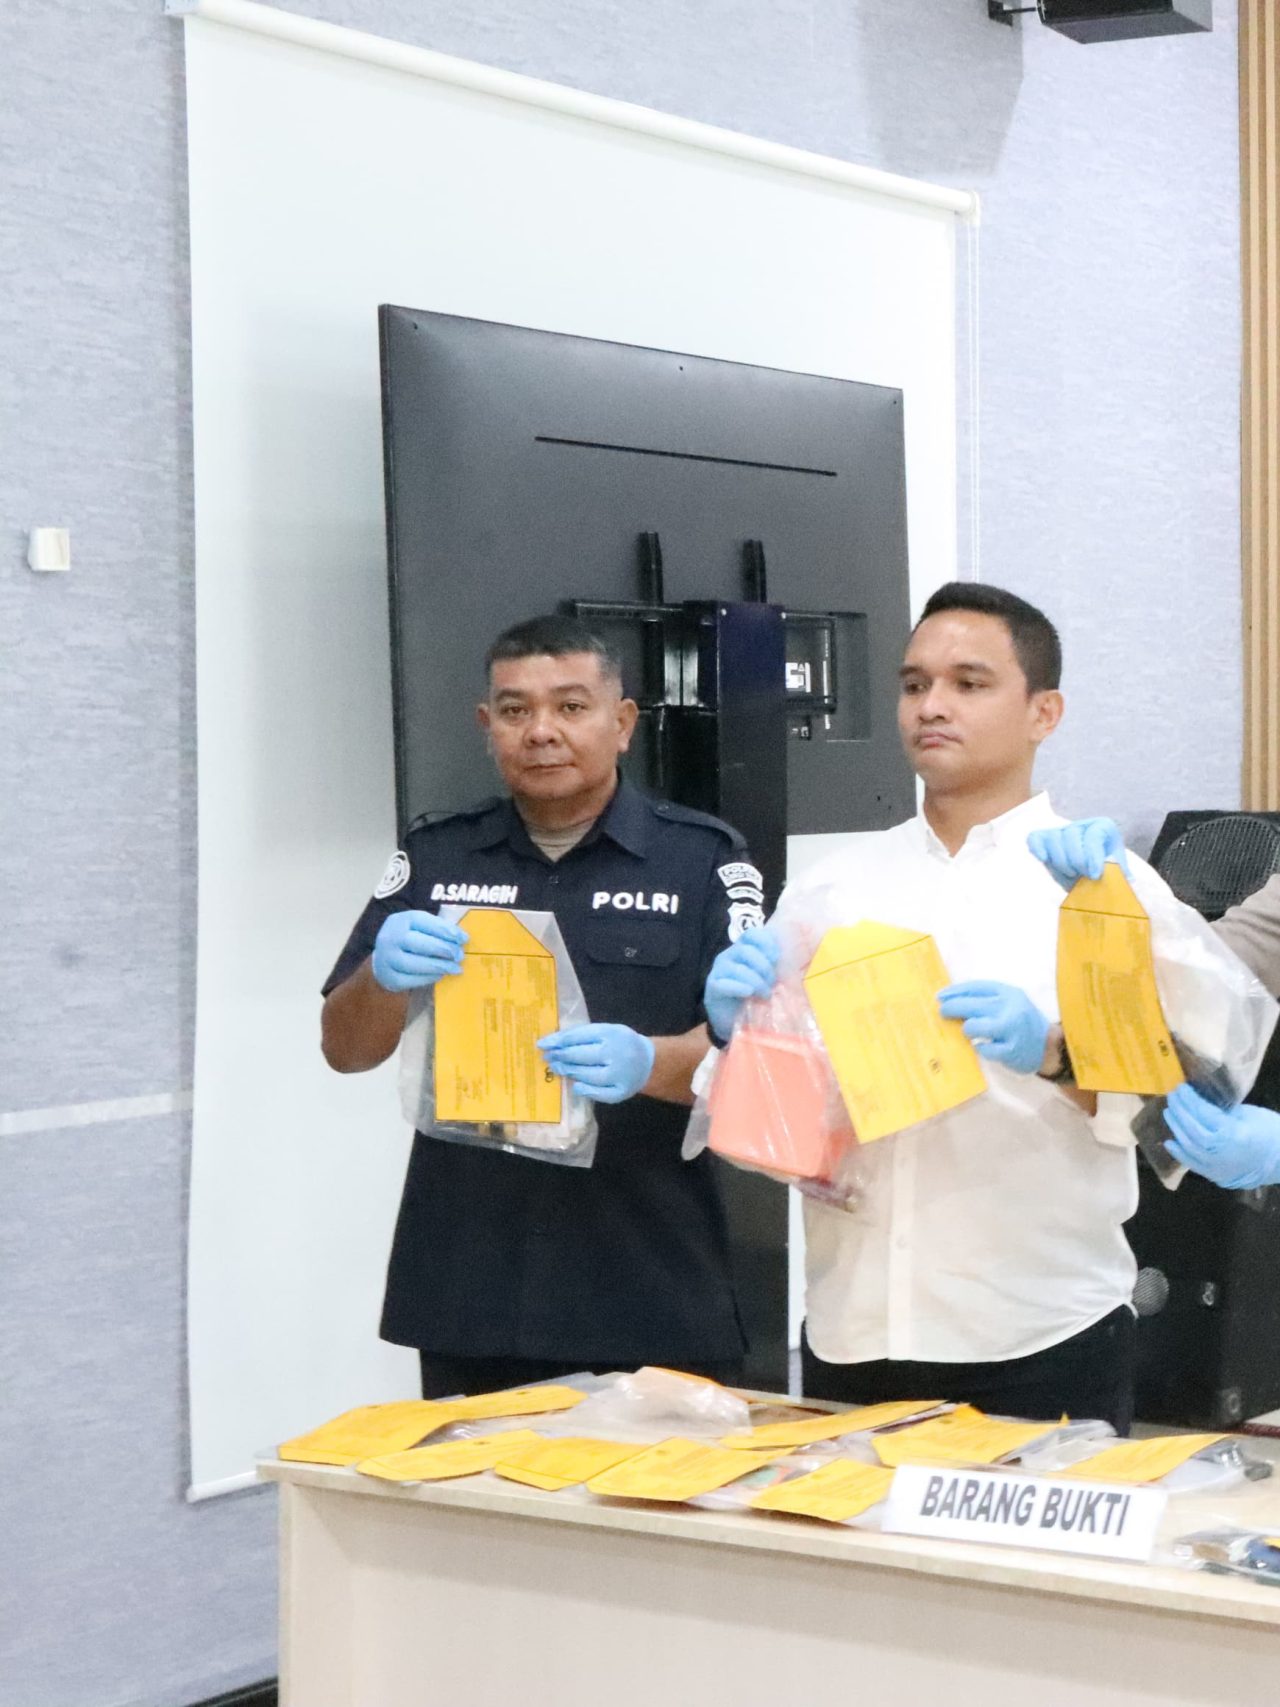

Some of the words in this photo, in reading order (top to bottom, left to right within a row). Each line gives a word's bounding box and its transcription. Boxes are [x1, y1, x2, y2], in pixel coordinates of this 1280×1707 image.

[592, 891, 679, 914] POLRI
[920, 1475, 1036, 1527] BARANG
[1039, 1487, 1131, 1536] BUKTI
